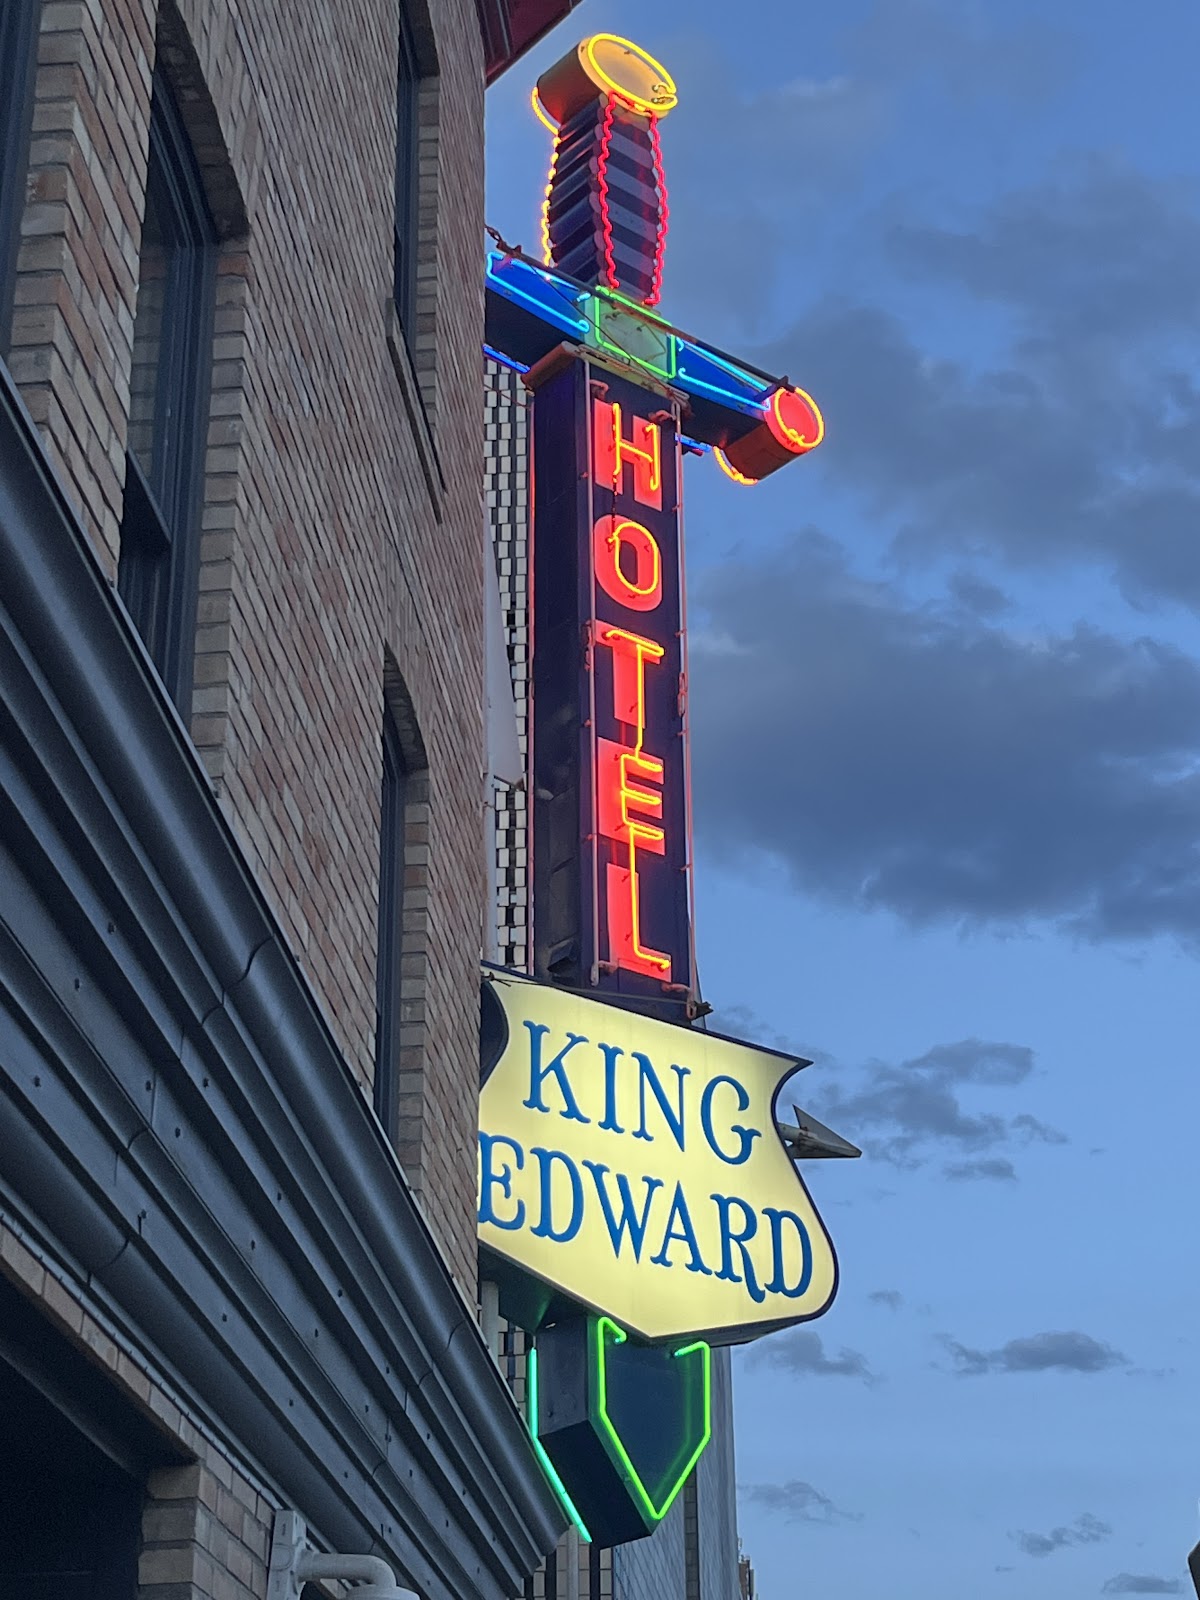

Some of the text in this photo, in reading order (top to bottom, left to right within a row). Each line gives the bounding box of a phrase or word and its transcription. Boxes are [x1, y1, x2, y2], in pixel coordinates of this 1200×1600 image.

[593, 397, 673, 984] HOTEL
[522, 1020, 762, 1166] KING
[478, 1134, 813, 1304] EDWARD
